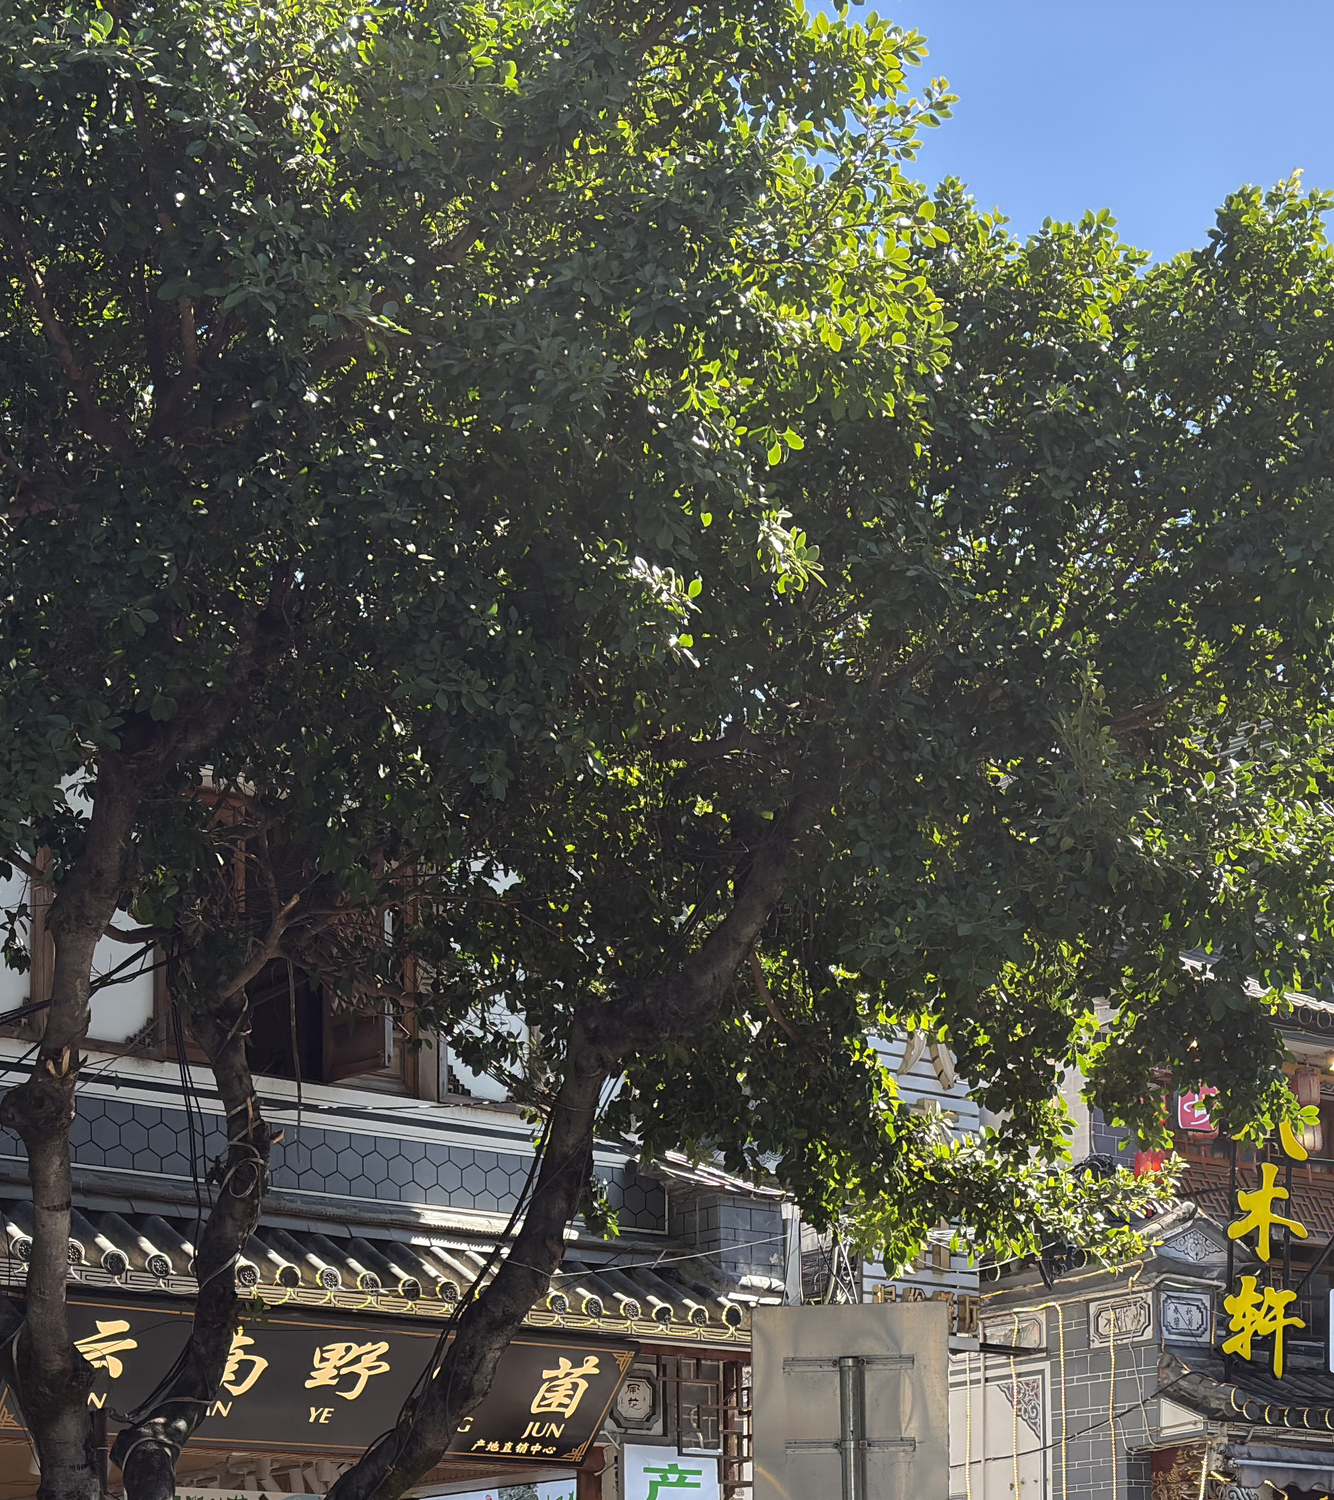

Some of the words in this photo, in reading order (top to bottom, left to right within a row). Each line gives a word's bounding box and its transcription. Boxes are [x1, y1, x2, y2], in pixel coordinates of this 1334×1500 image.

[308, 1406, 334, 1425] YE
[521, 1421, 565, 1439] JUN
[470, 1438, 557, 1455] 产地直销中心
